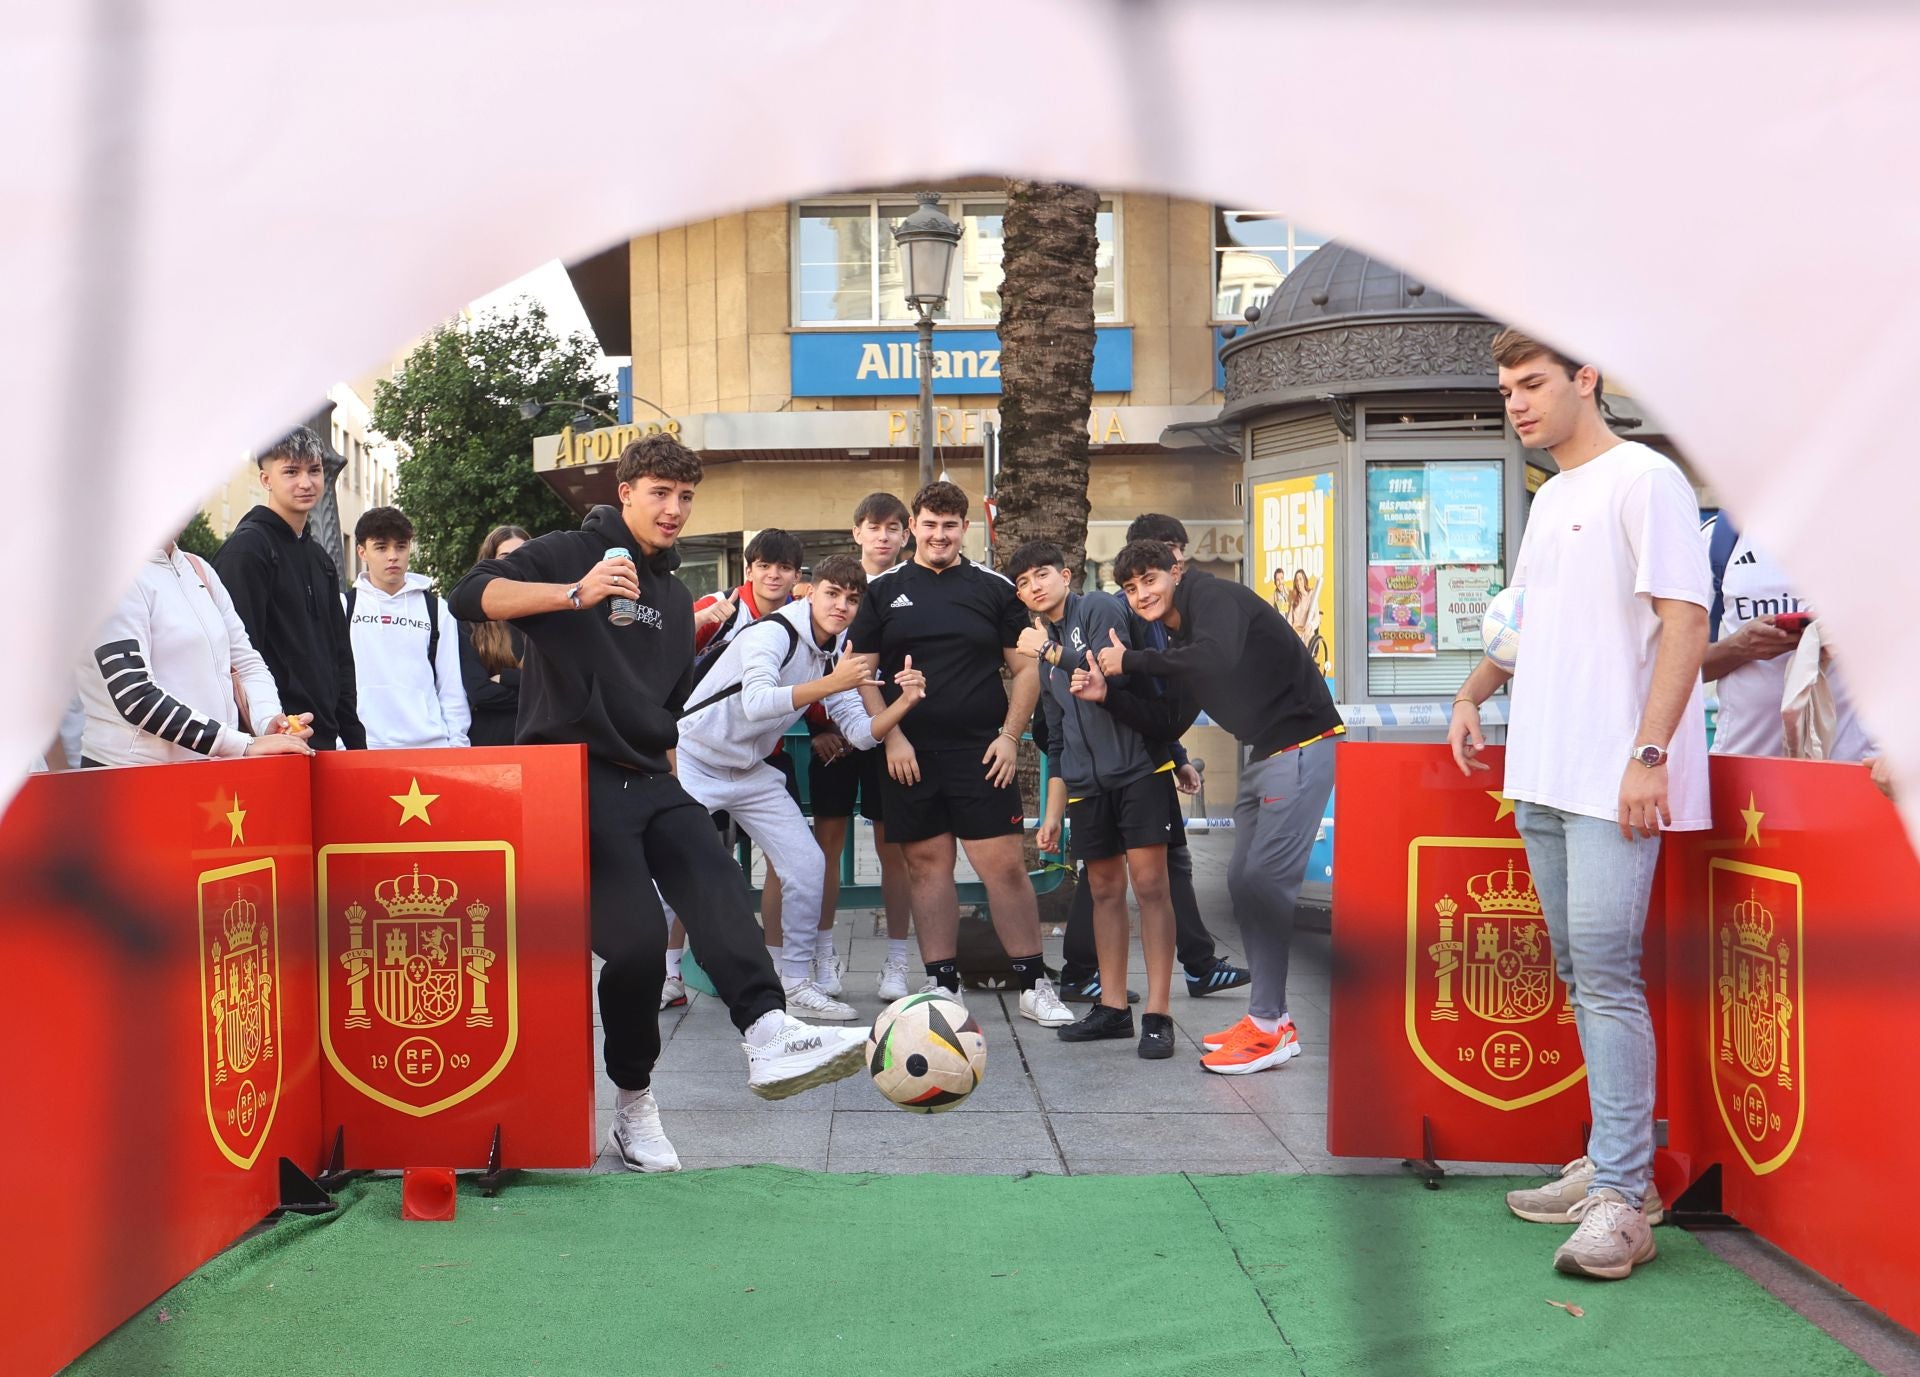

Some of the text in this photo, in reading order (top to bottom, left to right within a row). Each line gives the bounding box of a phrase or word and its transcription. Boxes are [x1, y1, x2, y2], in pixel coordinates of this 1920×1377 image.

[1263, 489, 1324, 552] BIEN
[1263, 546, 1324, 584] JUGADO
[392, 616, 431, 631] JONES
[1435, 942, 1458, 951] PLVS
[346, 950, 368, 959] PLVS
[464, 948, 492, 959] VLTRA
[406, 1049, 433, 1060] RF
[1457, 1047, 1475, 1062] 19
[1494, 1043, 1521, 1054] RF
[371, 1054, 388, 1069] 19
[450, 1053, 471, 1069] 09
[1494, 1057, 1521, 1068] EF
[1539, 1049, 1560, 1064] 09
[406, 1063, 433, 1074] EF
